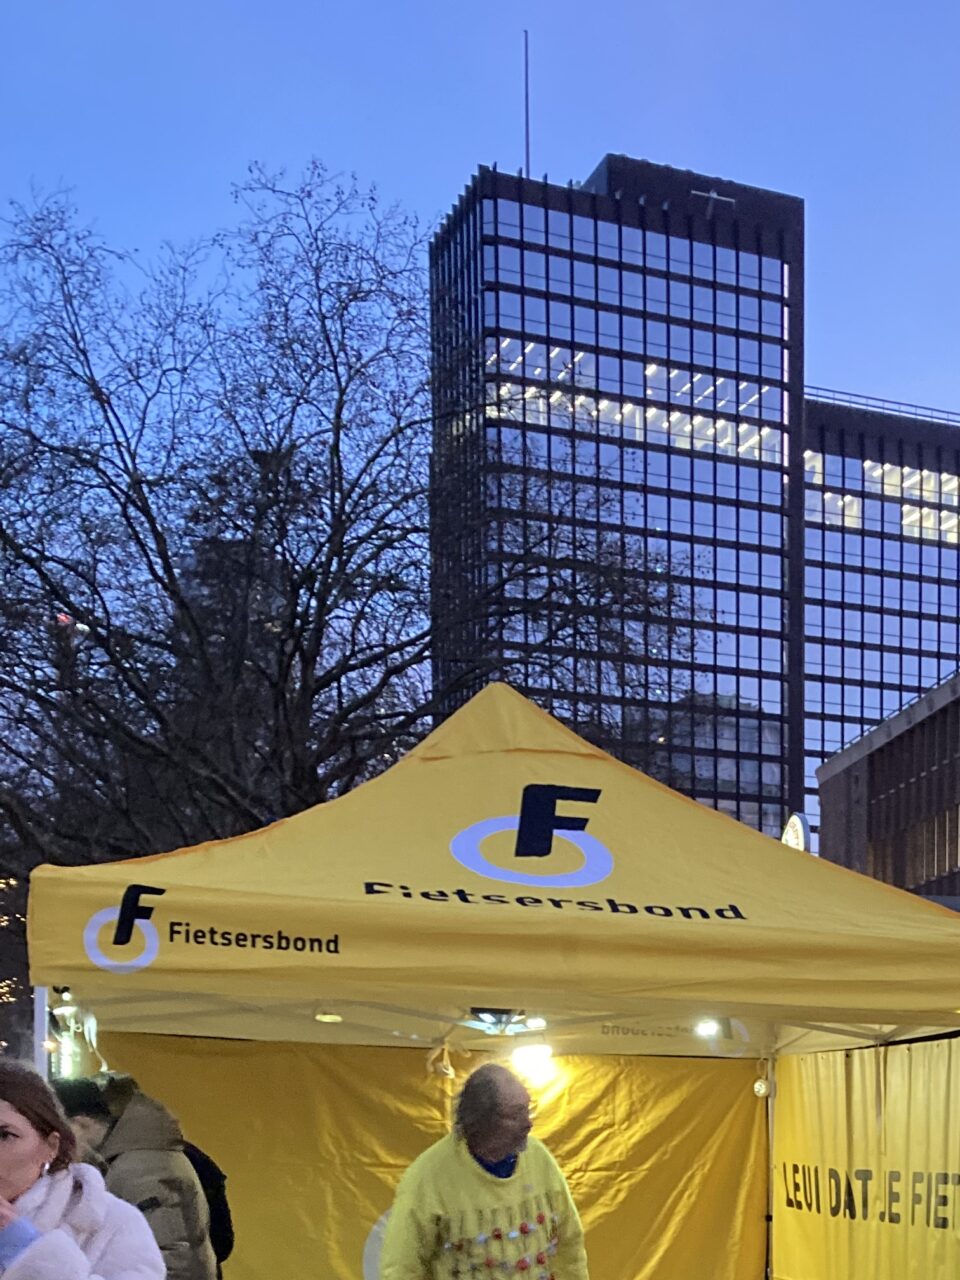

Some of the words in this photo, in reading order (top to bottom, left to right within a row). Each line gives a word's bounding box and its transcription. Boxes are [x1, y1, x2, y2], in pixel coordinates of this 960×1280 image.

[364, 881, 748, 921] Fietsersbond
[168, 921, 341, 955] Fietsersbond
[828, 1167, 873, 1221] DAT
[879, 1169, 901, 1225] JE
